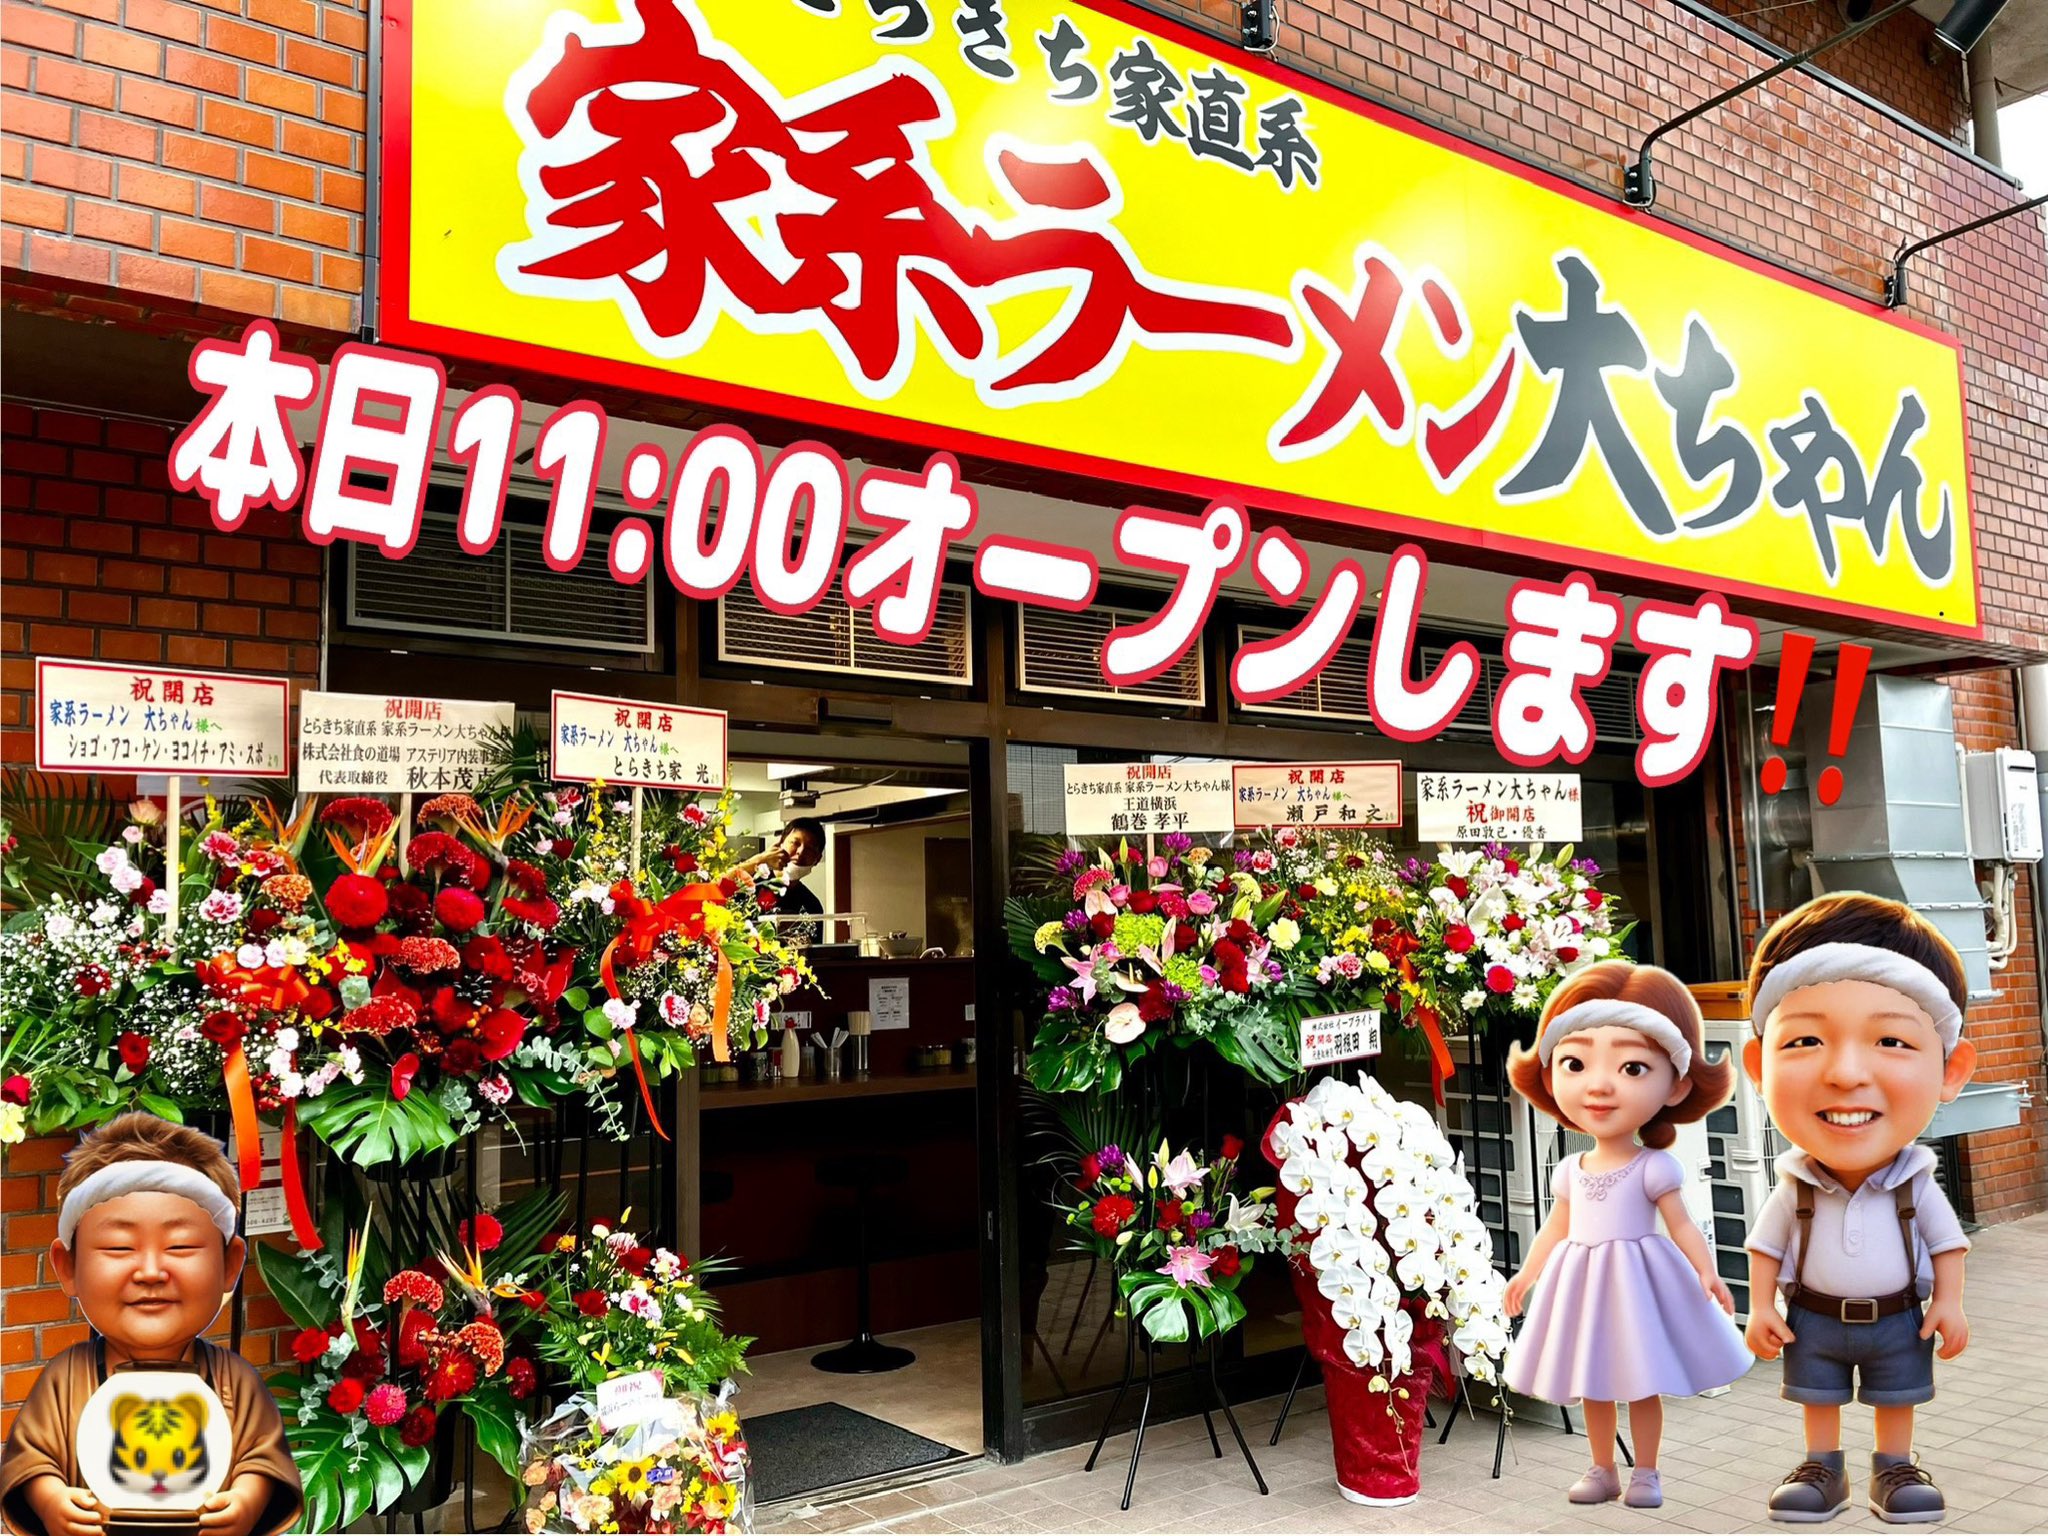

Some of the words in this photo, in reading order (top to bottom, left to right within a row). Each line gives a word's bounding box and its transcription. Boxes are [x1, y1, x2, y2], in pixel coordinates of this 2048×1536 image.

[797, 0, 1319, 187] きち家直系
[130, 676, 215, 706] 祝開店
[50, 699, 130, 727] 家系ラーメン
[384, 699, 443, 721] 祝開店
[614, 707, 673, 733] 祝開店
[302, 718, 377, 736] とらきち家直系
[561, 723, 614, 748] 家系ラーメン
[302, 742, 400, 763] 株式会社食の道場
[319, 770, 388, 785] 代表取締役
[613, 755, 682, 783] とらきち家
[1127, 764, 1172, 780] 祝開店
[1288, 768, 1346, 784] 祝開店
[1066, 781, 1122, 795] とらきち家直系
[1125, 779, 1232, 794] 家系ラーメン大ちゃん様
[1238, 786, 1289, 803] 家系ラーメン
[1420, 775, 1580, 802] 家系ラーメン大ちゃん様
[1123, 796, 1177, 811] 王道横浜
